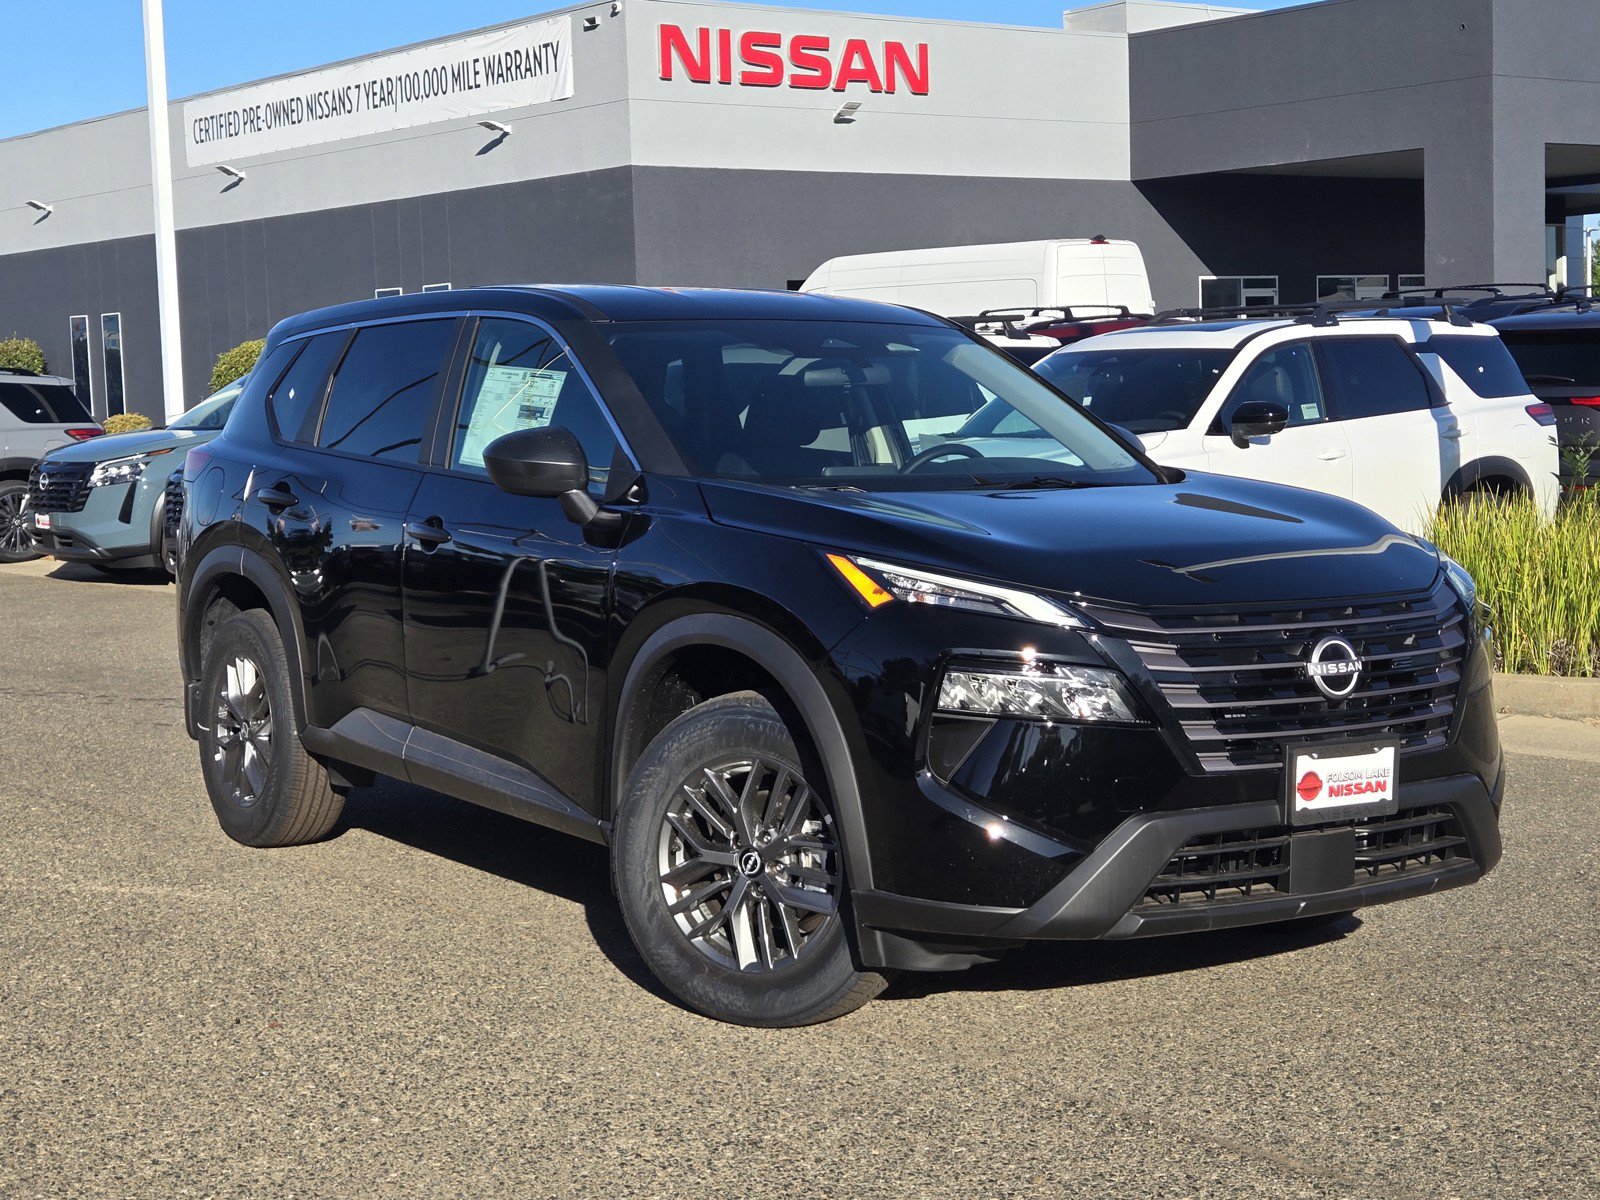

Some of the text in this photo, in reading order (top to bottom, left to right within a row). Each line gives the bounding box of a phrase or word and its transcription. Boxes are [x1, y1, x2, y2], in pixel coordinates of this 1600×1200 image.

[658, 23, 929, 96] NISSAN
[193, 110, 240, 145] CERTIFIED
[243, 96, 304, 134] PRE-OWNED
[305, 85, 352, 122] NISSANS
[354, 84, 361, 112] 7
[451, 58, 481, 93] MILE
[482, 40, 560, 87] WARRANTY
[1310, 661, 1362, 674] NISSAN
[1326, 768, 1391, 783] FOLSOM LAKE
[1328, 780, 1387, 798] NISSAN
